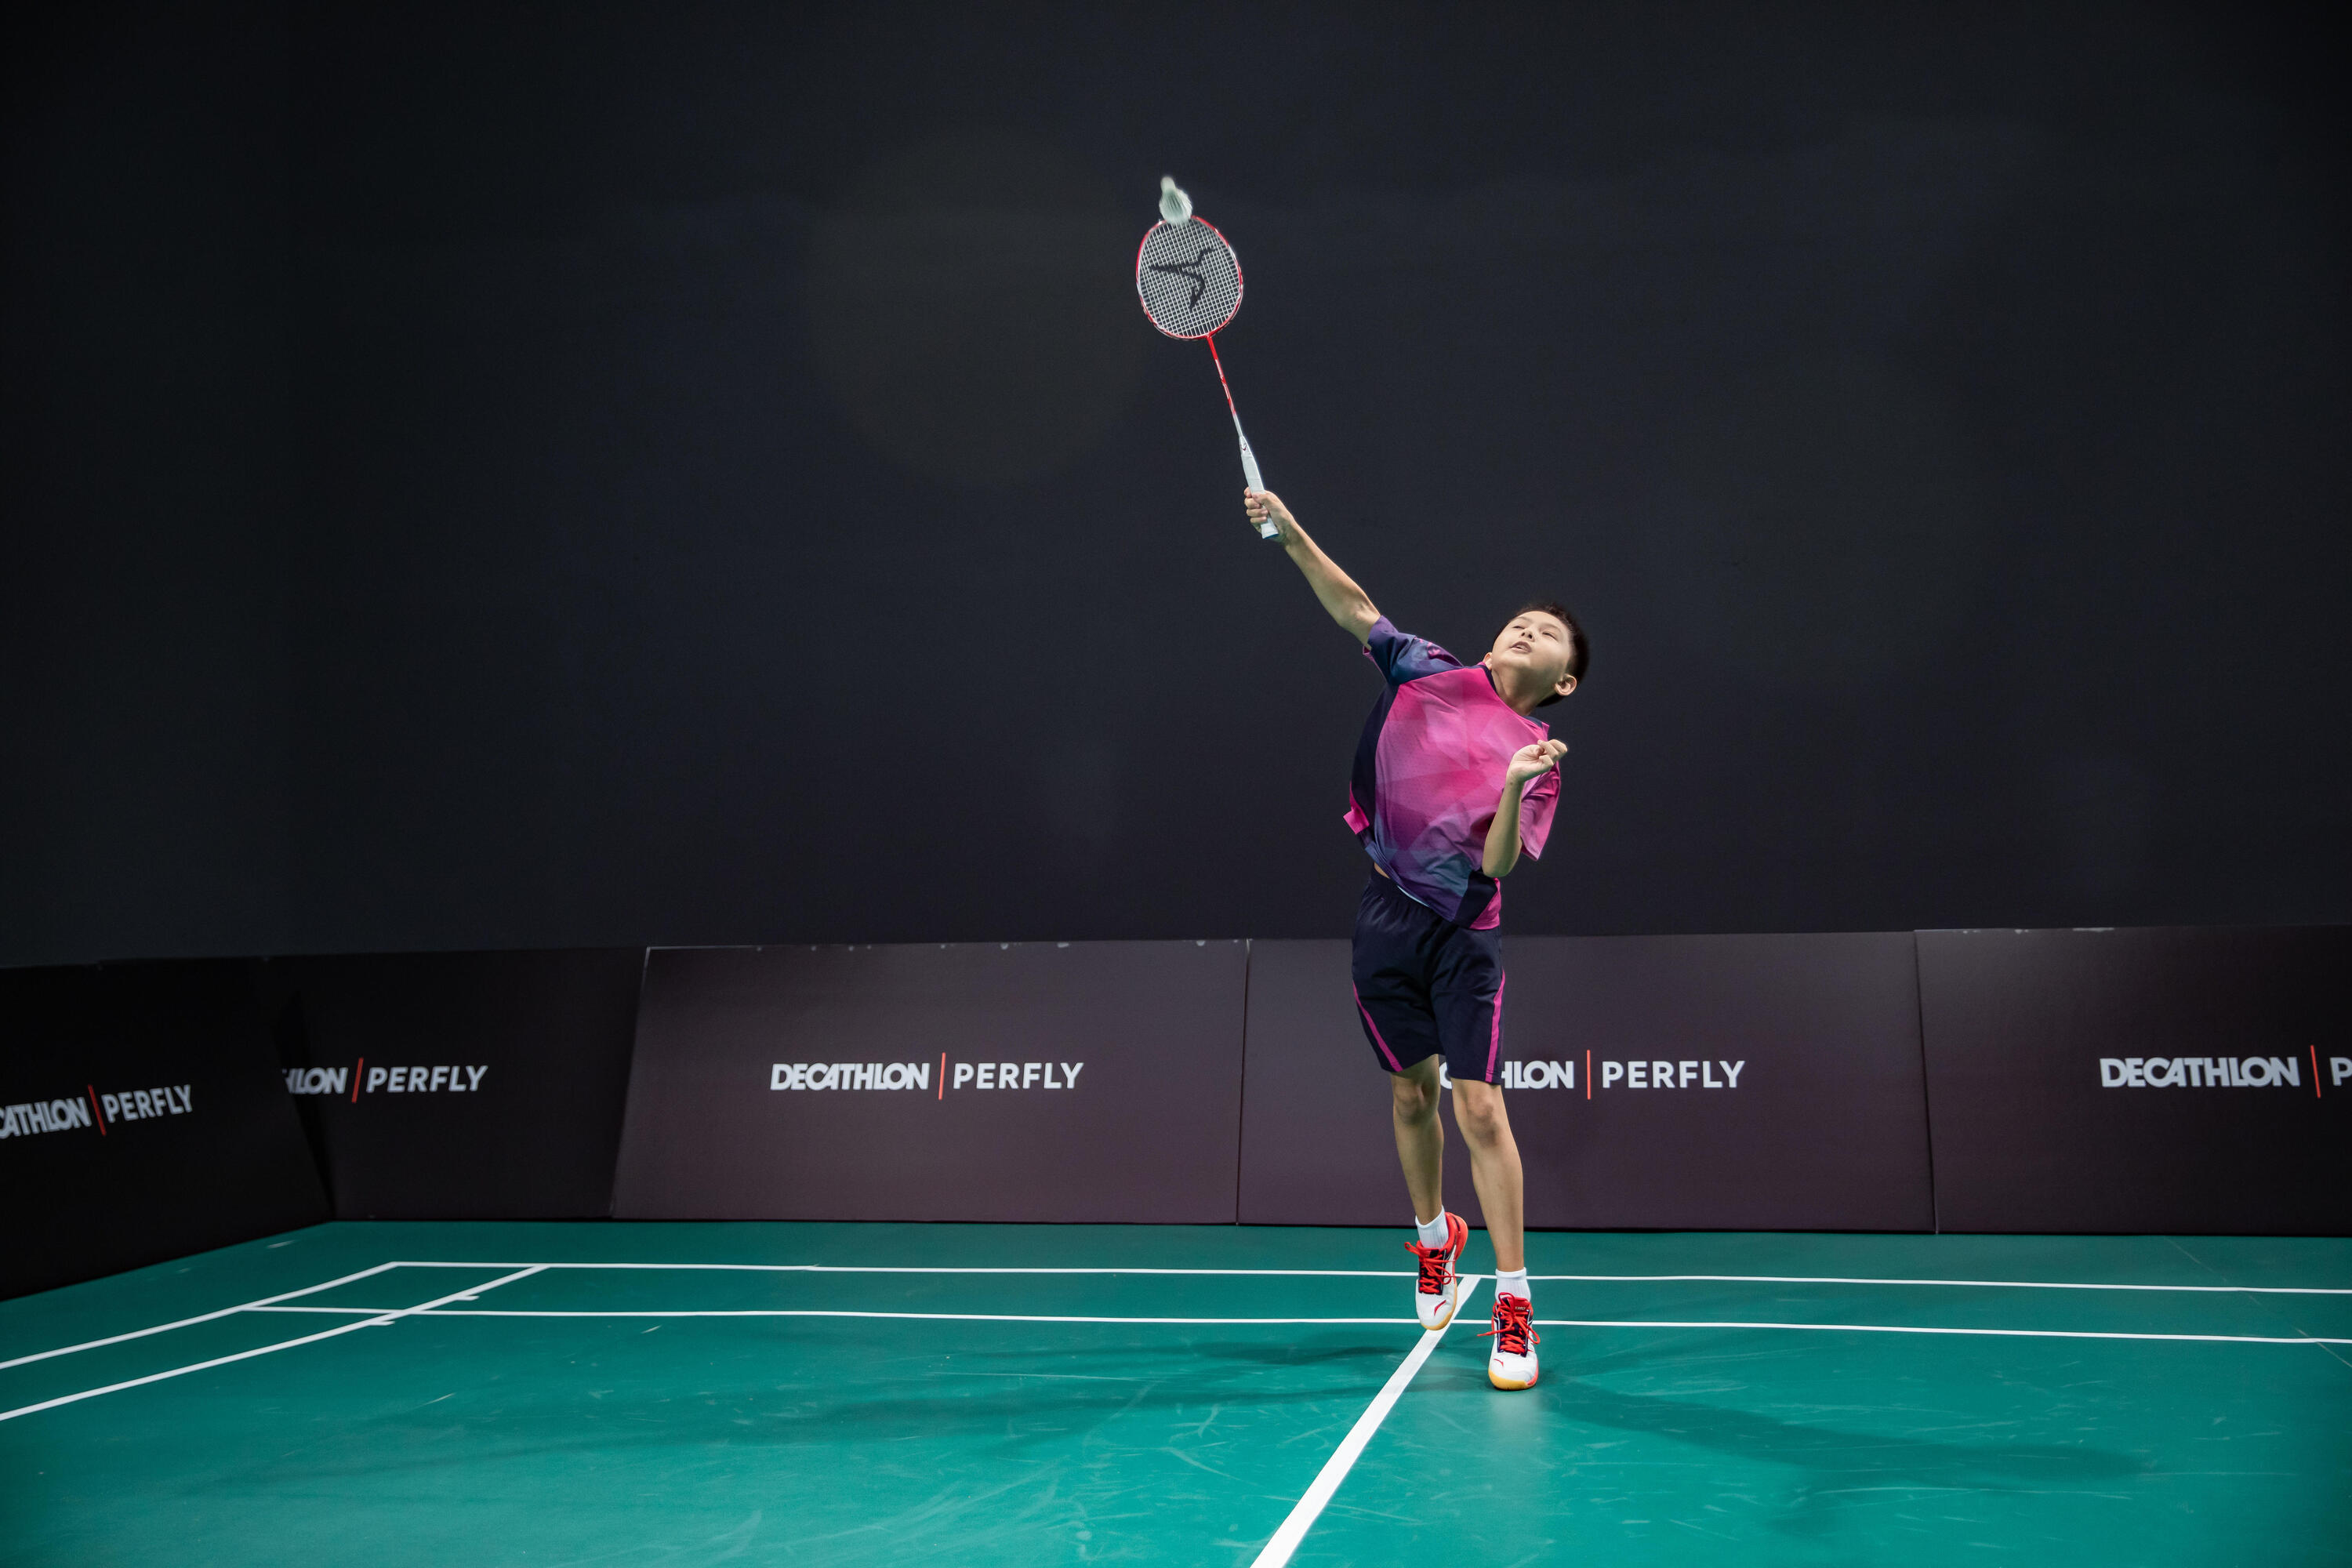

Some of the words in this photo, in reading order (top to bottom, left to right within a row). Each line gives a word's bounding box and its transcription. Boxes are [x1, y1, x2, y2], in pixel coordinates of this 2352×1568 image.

[365, 1065, 488, 1093] PERFLY
[770, 1063, 931, 1091] DECATHLON
[953, 1062, 1084, 1089] PERFLY
[1602, 1061, 1745, 1089] PERFLY
[2100, 1057, 2300, 1087] DECATHLON
[102, 1085, 193, 1123] PERFLY
